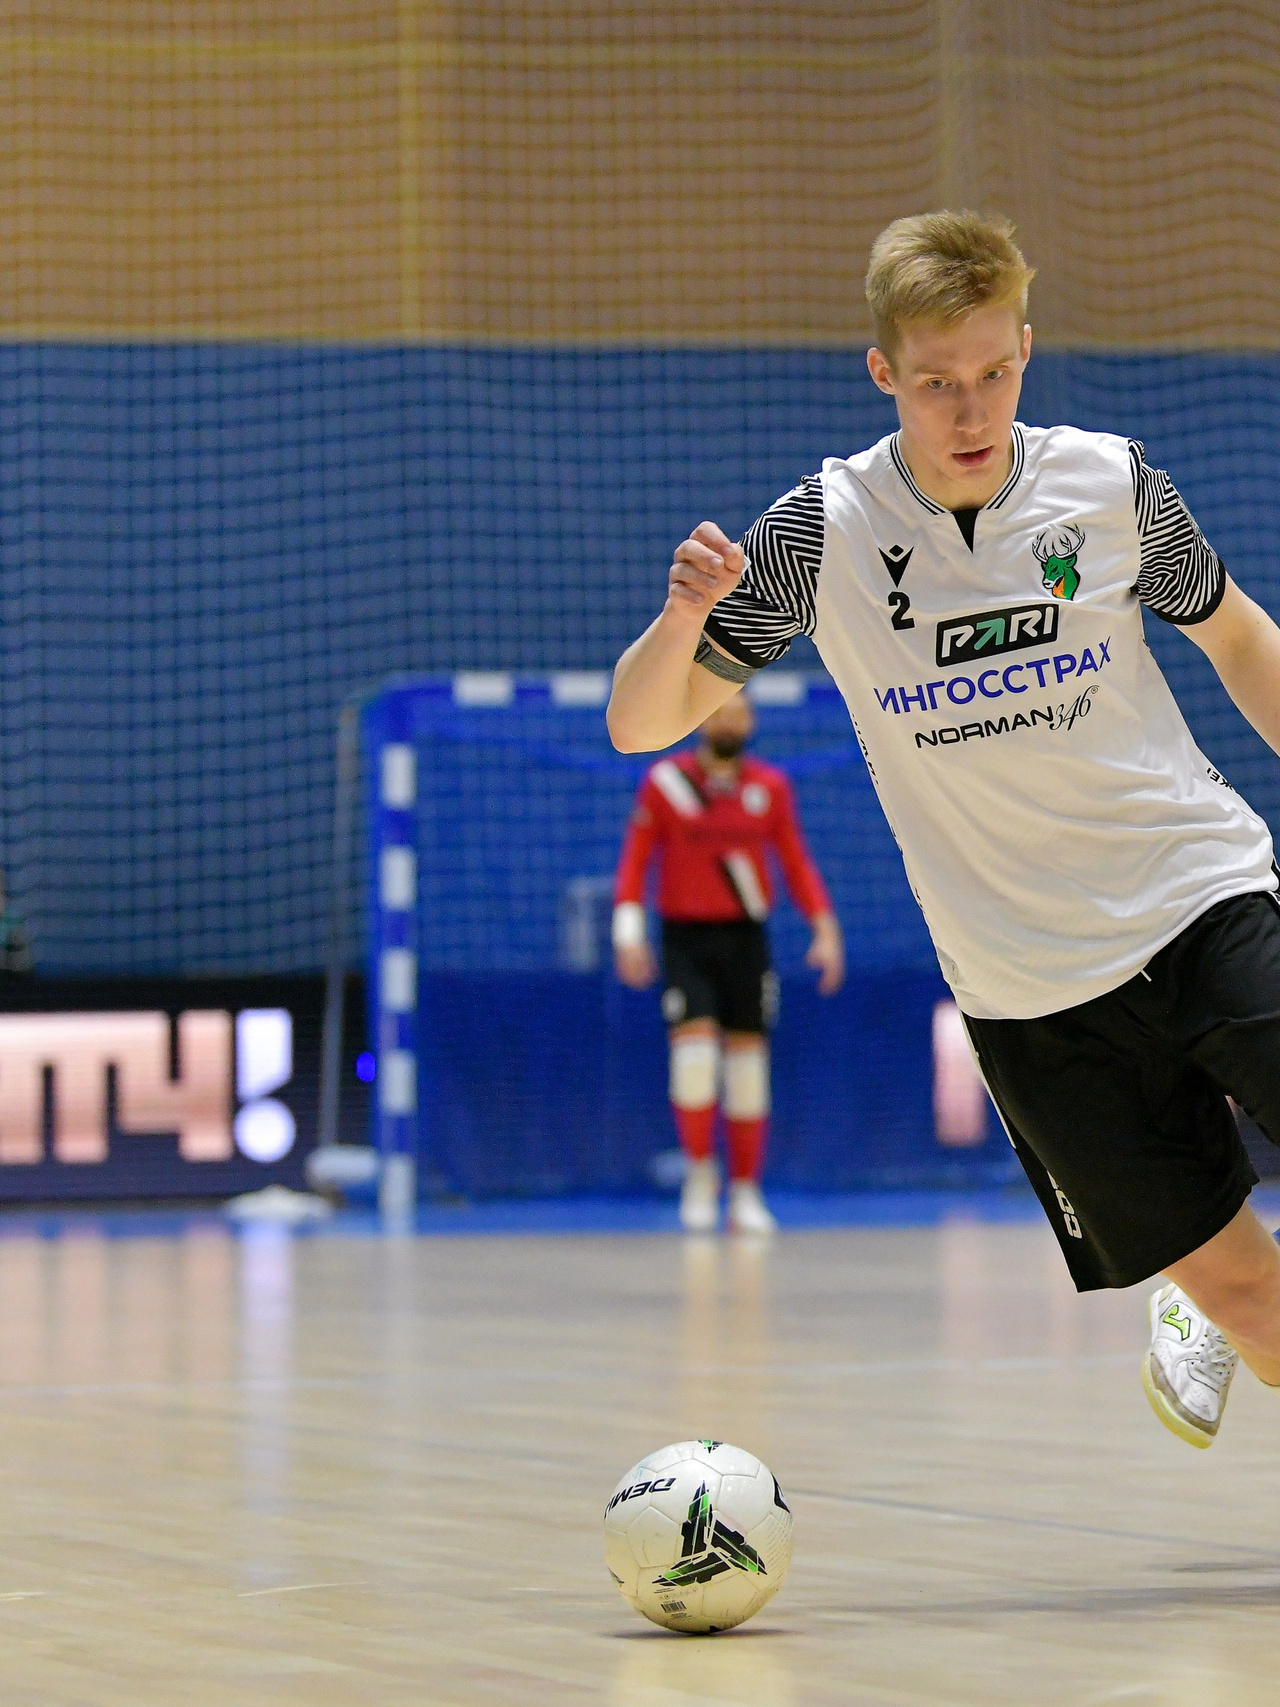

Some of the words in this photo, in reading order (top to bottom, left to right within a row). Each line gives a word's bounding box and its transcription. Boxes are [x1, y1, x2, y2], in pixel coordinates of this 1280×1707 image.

[887, 591, 916, 631] 2
[940, 606, 1055, 659] PARI
[873, 636, 1112, 714] ИНГОССТРАХ
